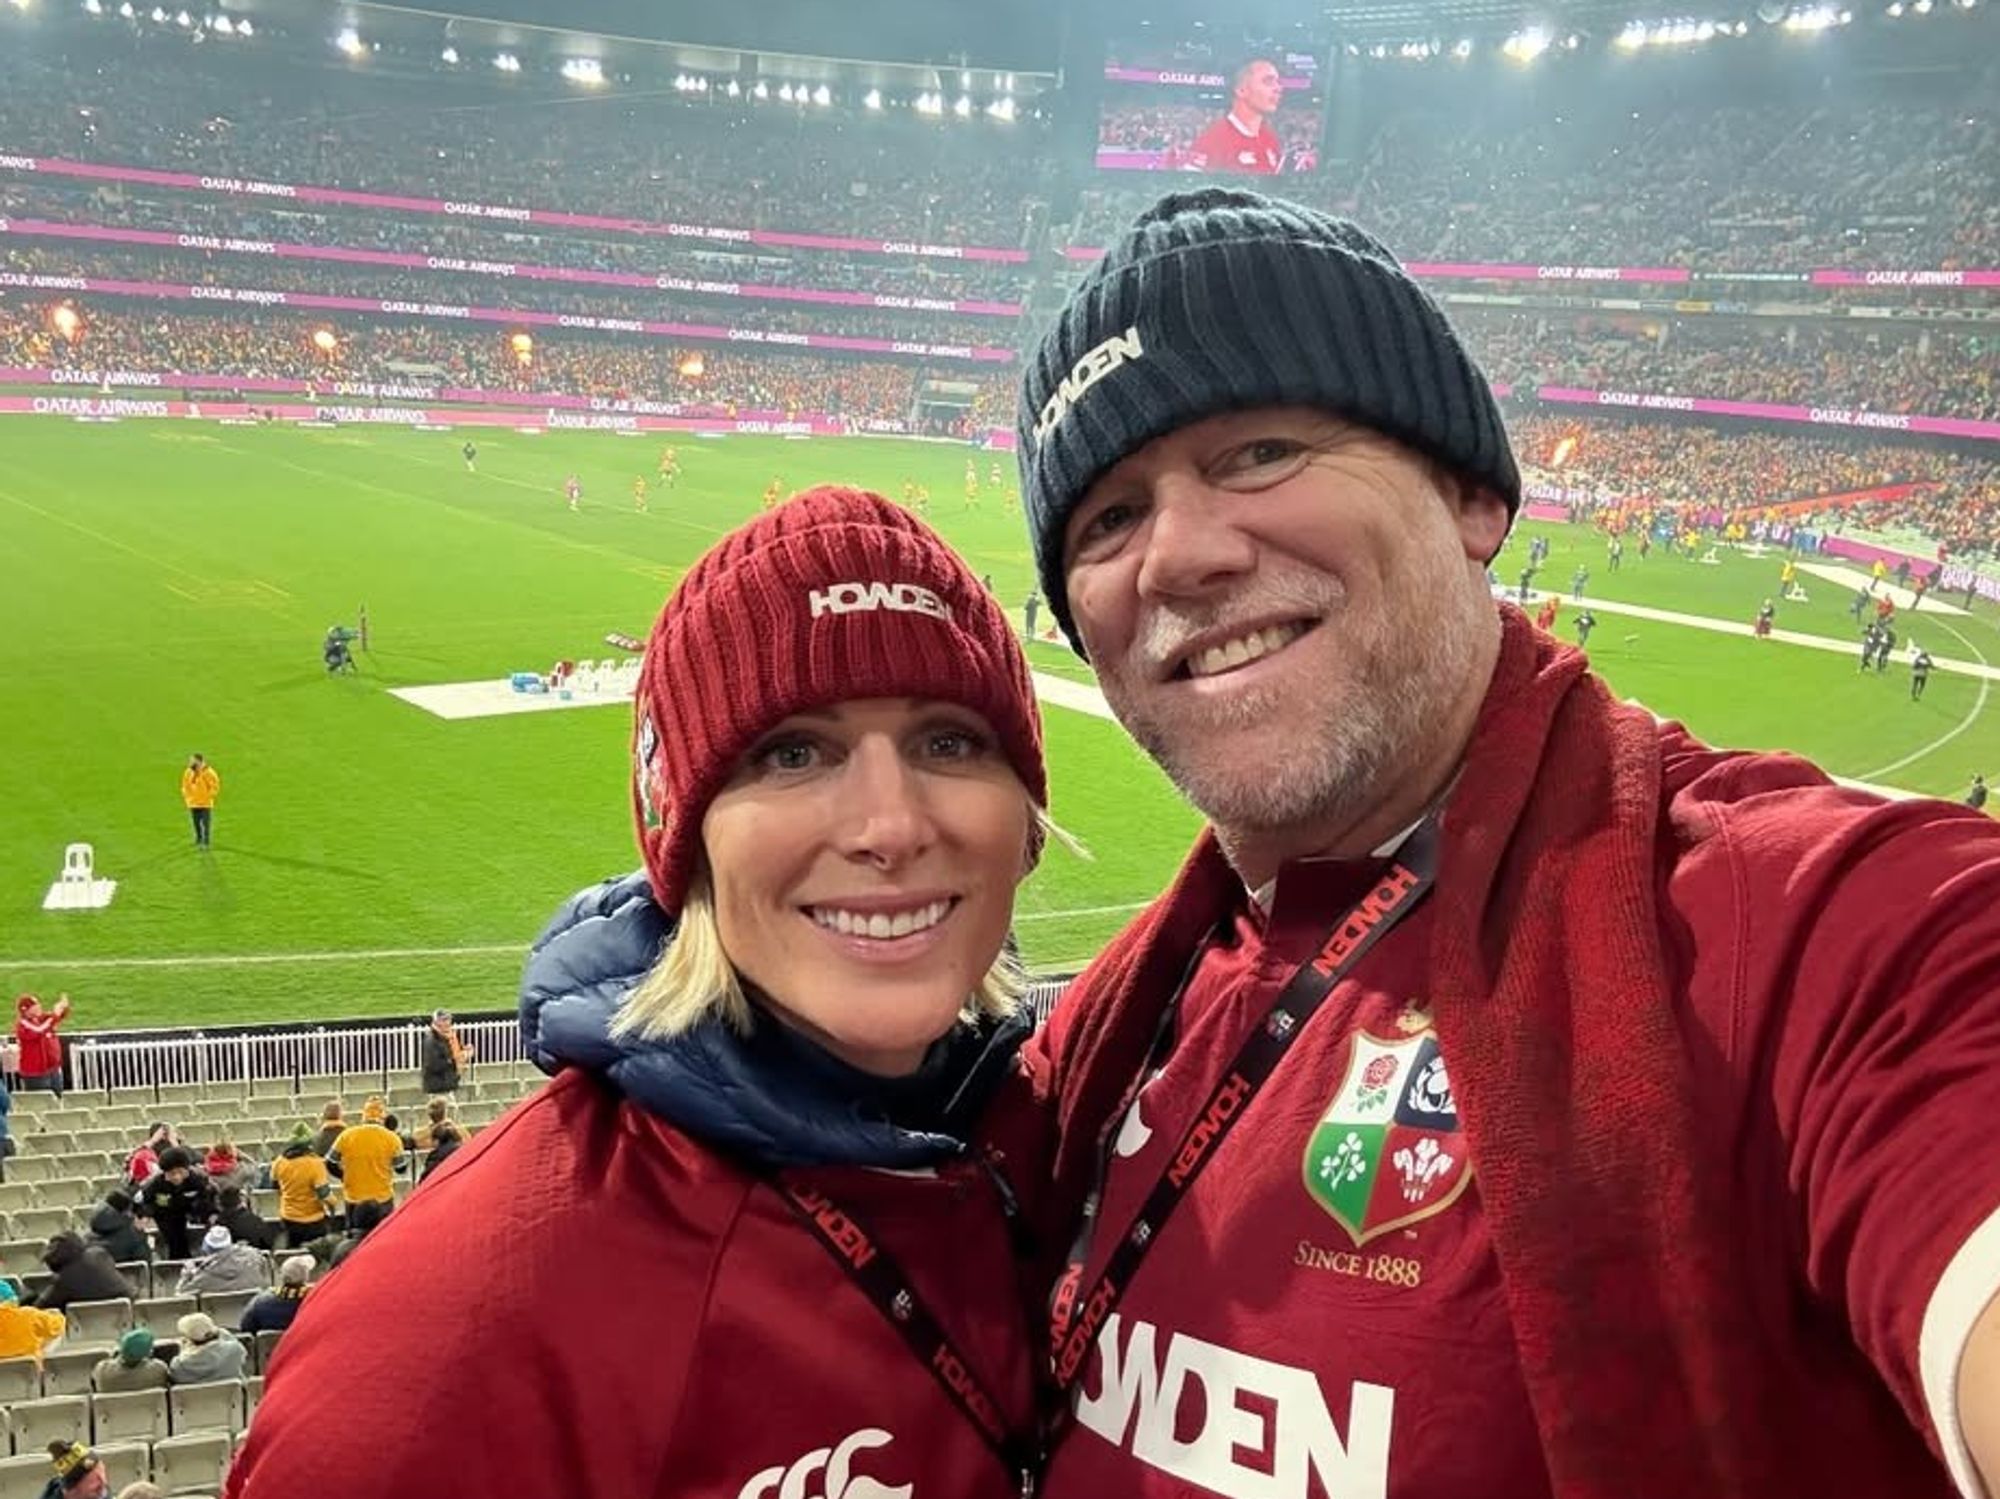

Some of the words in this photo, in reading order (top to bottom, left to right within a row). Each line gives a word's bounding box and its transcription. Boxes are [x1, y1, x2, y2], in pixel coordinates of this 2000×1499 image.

[201, 176, 242, 192] QATAR
[246, 181, 296, 197] AIRWAYS
[444, 201, 483, 217] QATAR
[484, 206, 531, 221] AIRWAYS
[178, 234, 221, 249] QATAR
[225, 239, 275, 254] AIRWAYS
[1538, 267, 1573, 280] QATAR
[1575, 268, 1621, 281] AIRWAYS
[1865, 270, 1908, 285] QATAR
[1910, 270, 1965, 286] AIRWAYS
[191, 286, 232, 300] QATAR
[236, 289, 286, 304] AIRWAYS
[51, 368, 100, 384] QATAR
[103, 370, 161, 386] AIRWAYS
[334, 382, 375, 396] QATAR
[379, 384, 434, 399] AIRWAYS
[33, 397, 93, 414] QATAR
[97, 399, 168, 417] AIRWAYS
[1599, 392, 1639, 405] QATAR
[1641, 394, 1696, 411] AIRWAYS
[1809, 408, 1851, 425] QATAR
[1853, 410, 1911, 430] AIRWAYS
[808, 581, 953, 620] HOWDEN
[1311, 863, 1419, 978] HOWDEN
[1168, 1072, 1251, 1188] HOWDEN
[1294, 1240, 1362, 1276] SINCE
[1365, 1253, 1421, 1288] 1888
[1050, 1262, 1083, 1350] WDEN
